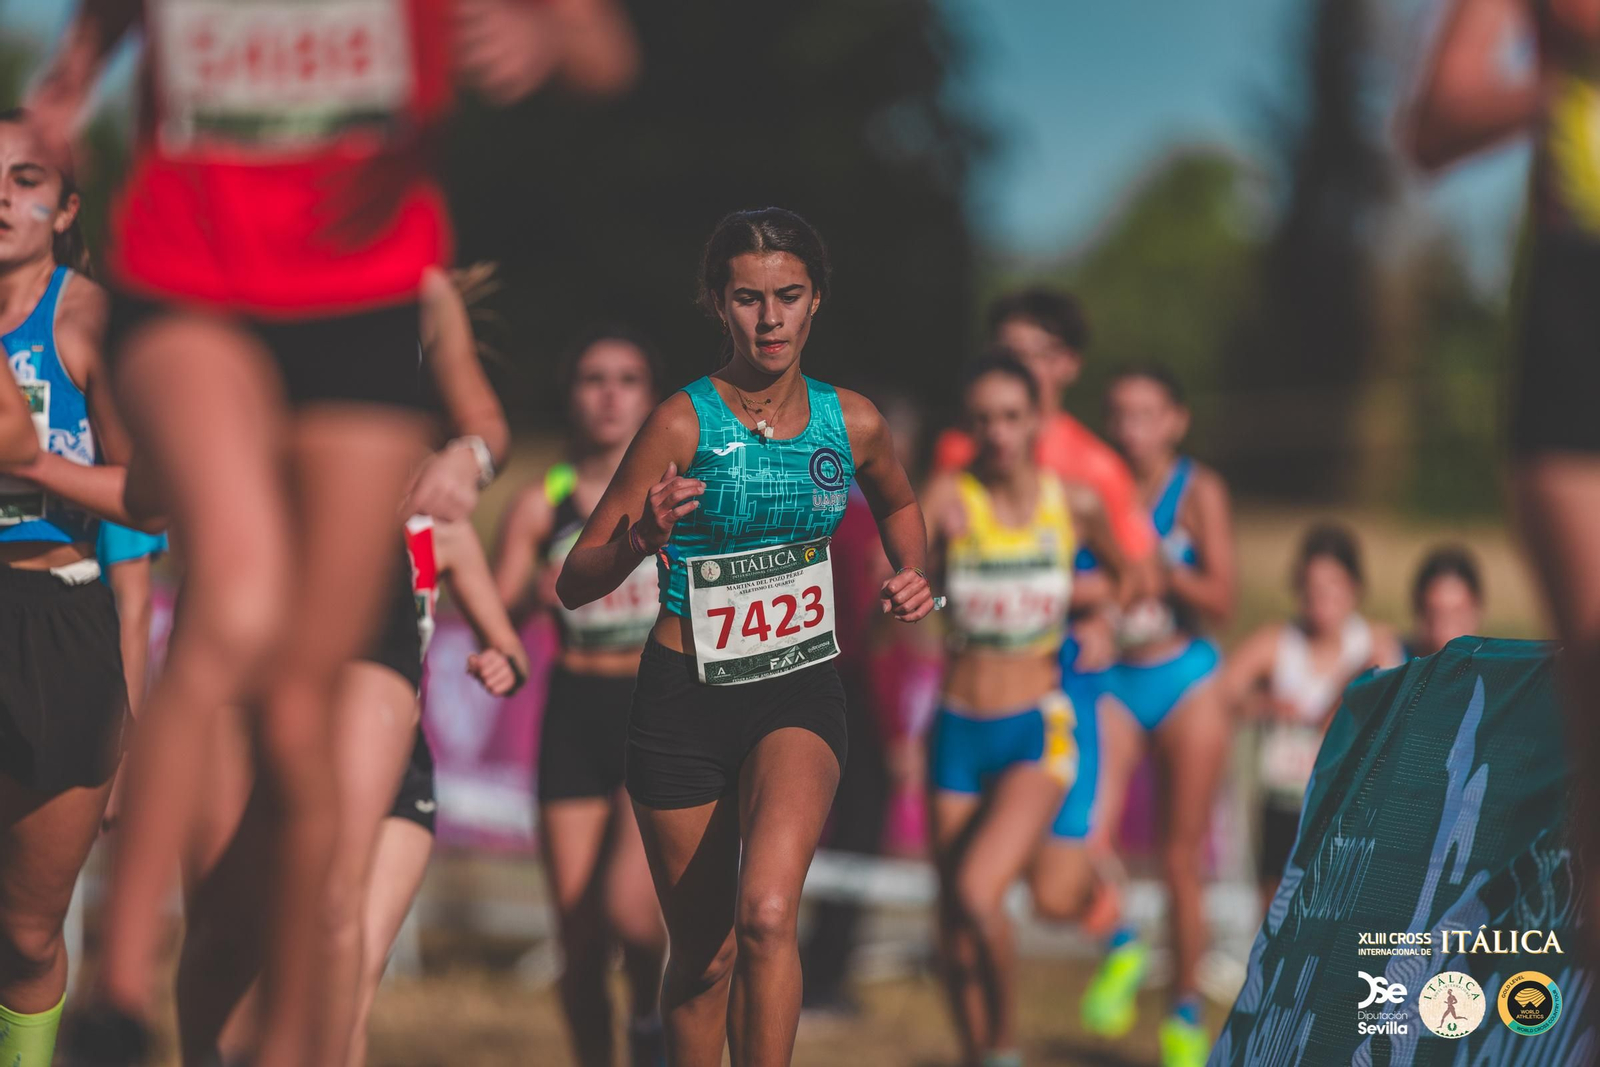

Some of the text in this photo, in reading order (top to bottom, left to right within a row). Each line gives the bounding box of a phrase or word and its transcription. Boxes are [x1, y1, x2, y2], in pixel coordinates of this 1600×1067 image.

[730, 550, 796, 574] ITÁLICA
[726, 582, 755, 591] MARTINA
[770, 574, 786, 584] POZO
[739, 585, 767, 595] ATLETISMO
[775, 579, 795, 589] QUARTO
[707, 585, 825, 650] 7423
